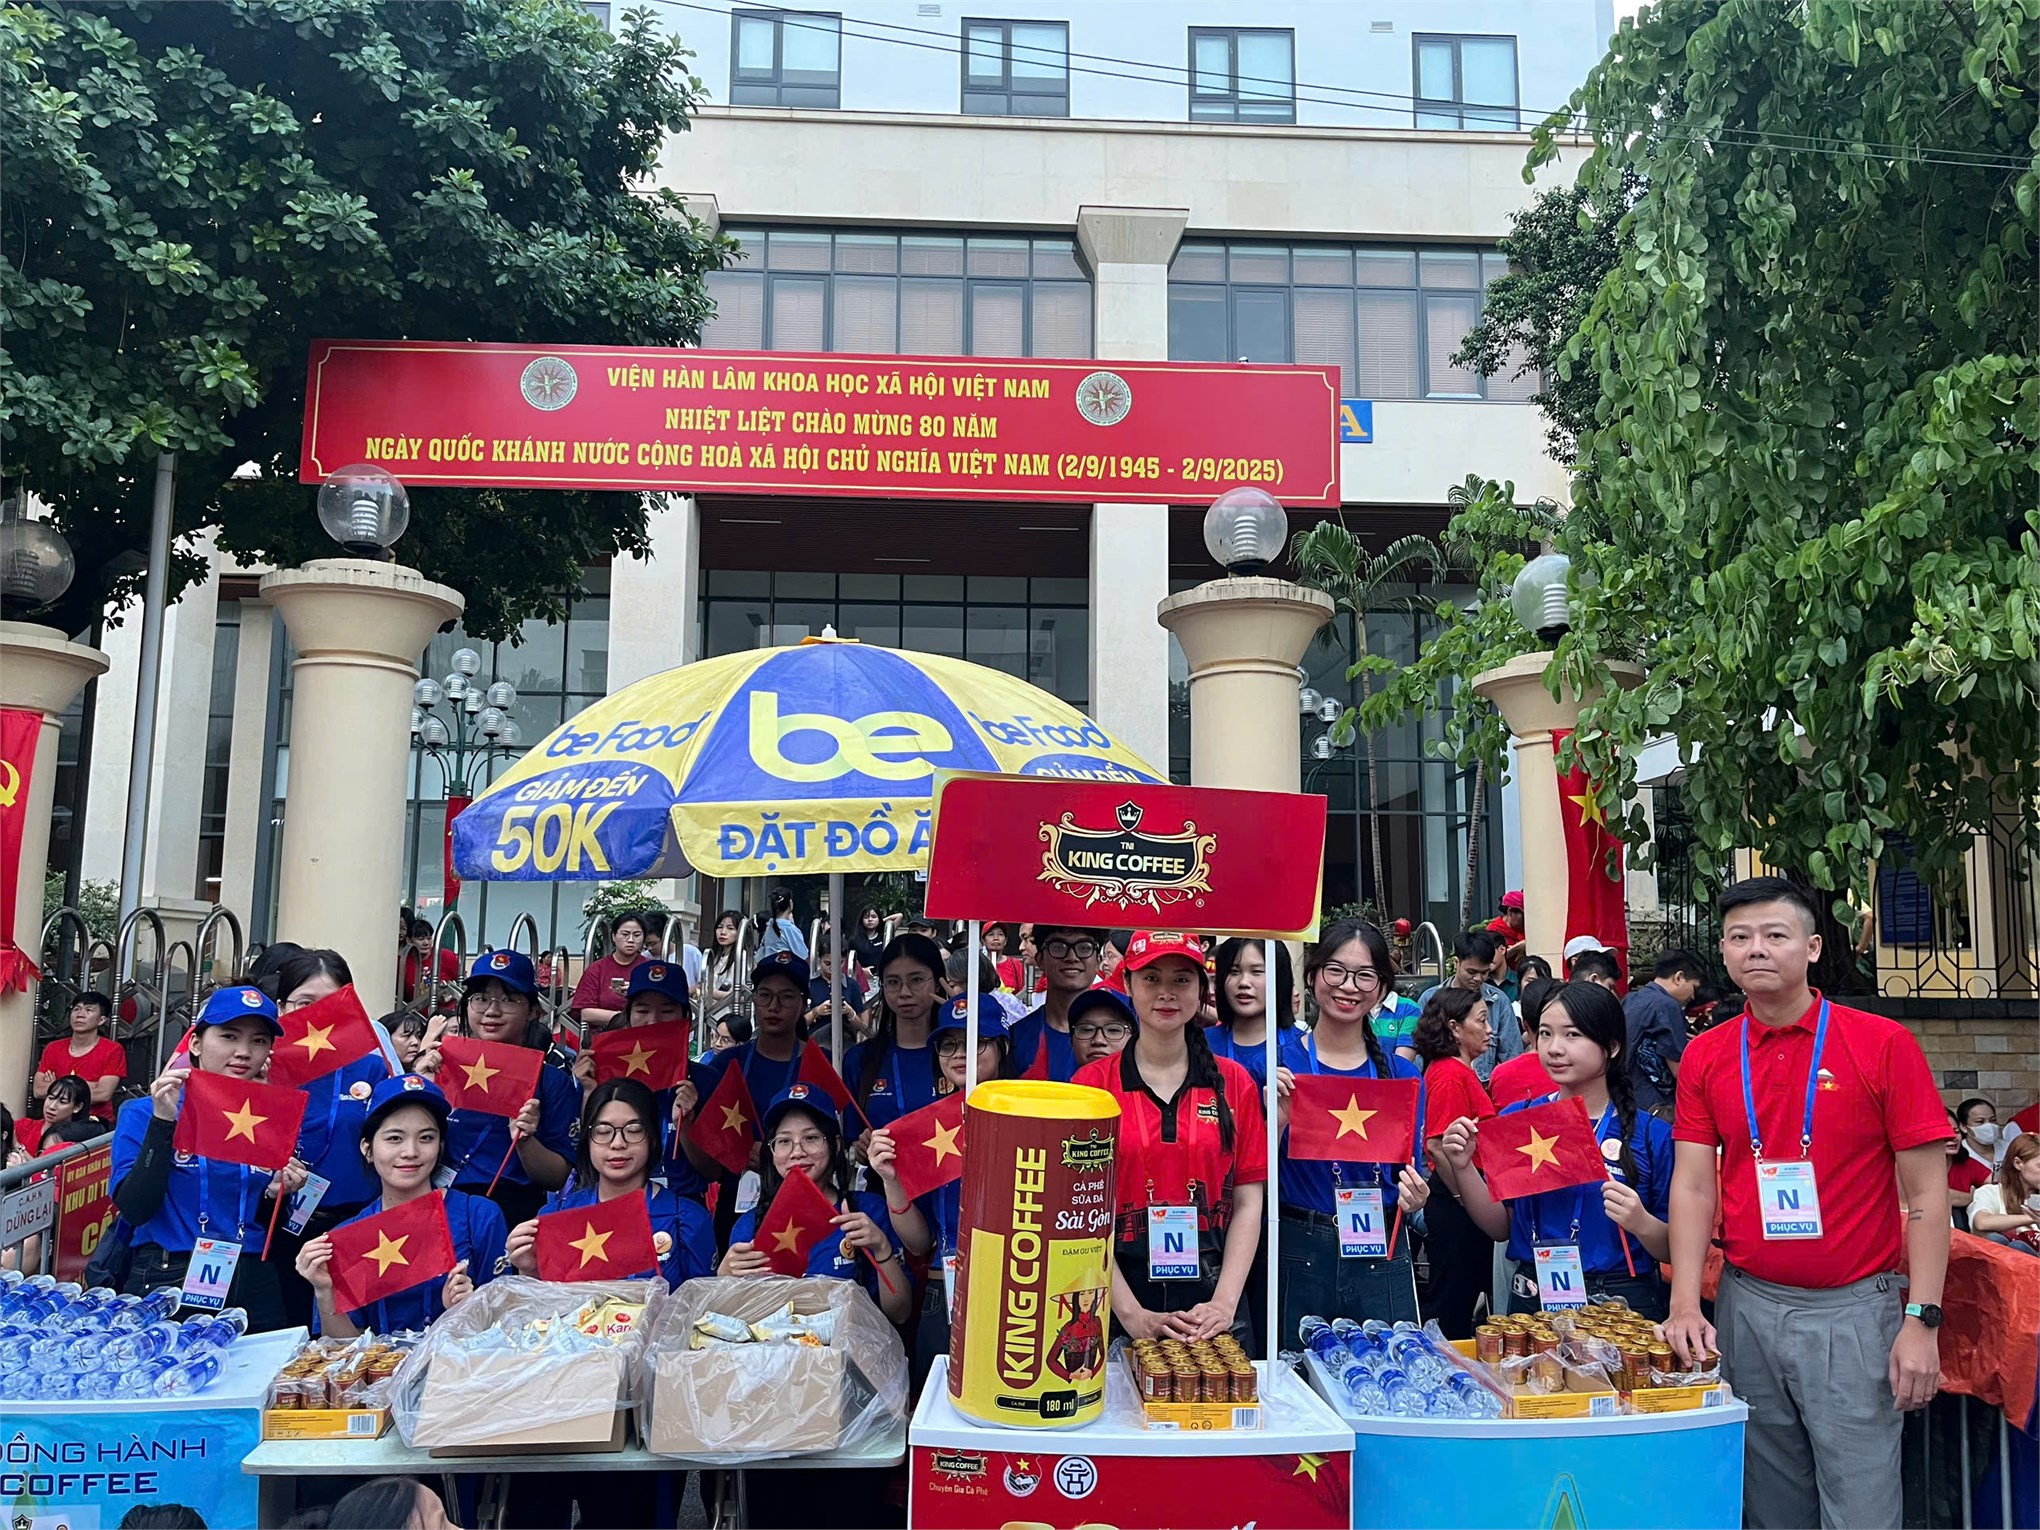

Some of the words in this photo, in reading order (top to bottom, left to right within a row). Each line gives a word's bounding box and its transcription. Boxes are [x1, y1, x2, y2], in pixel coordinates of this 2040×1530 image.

[608, 365, 655, 389] VIỆN
[663, 369, 705, 389] HÀN
[712, 370, 756, 390] LÂM
[763, 372, 819, 392] KHOA
[826, 374, 869, 396] HỌC
[876, 372, 903, 395] XÃ
[909, 373, 945, 399] HỘI
[952, 374, 997, 400] VIỆT
[1004, 379, 1050, 398] NAM
[665, 408, 731, 432] NHIỆT
[737, 408, 786, 433] LIỆT
[792, 411, 847, 435] CHÀO
[853, 414, 913, 436] MỪNG
[919, 415, 946, 437] 80
[953, 414, 997, 438] NĂM
[365, 437, 423, 460] NGÀY
[429, 436, 485, 462] QUỐC
[492, 439, 565, 463] KHÁNH
[573, 442, 630, 465] NƯỚC
[637, 441, 693, 468] CỘNG
[700, 445, 743, 468] HOÀ
[749, 446, 776, 469] XÃ
[783, 444, 819, 472] HỘI
[827, 448, 870, 472] CHỦ
[877, 450, 942, 474] NGHĨA
[948, 451, 998, 476] VIỆT
[1004, 453, 1050, 476] NAM
[1057, 454, 1160, 479] (2/9/1945
[1182, 458, 1284, 482] 2/9/2025)
[546, 725, 596, 758] be
[597, 711, 710, 754] Food
[749, 691, 953, 782] be
[968, 710, 1030, 746] be
[1018, 714, 1110, 749] Food
[515, 770, 589, 802] GIẢM
[584, 762, 648, 795] ĐẾN
[491, 801, 623, 873] 50K
[717, 810, 815, 871] ĐẶT
[824, 796, 907, 858] ĐỒ
[1068, 850, 1114, 872] KING
[1115, 853, 1186, 876] COFFEE
[1073, 1180, 1087, 1191] CÀ
[1088, 1179, 1105, 1191] PHÊ
[65, 1187, 86, 1214] KHU
[1071, 1193, 1092, 1205] SỮA
[1093, 1191, 1104, 1203] ĐÁ
[1777, 1188, 1800, 1211] N
[1010, 1146, 1047, 1285] COFFEE
[1055, 1210, 1085, 1231] Sài
[1088, 1208, 1111, 1233] Gòn
[1351, 1213, 1371, 1233] N
[1770, 1222, 1798, 1234] PHỤC
[1799, 1222, 1813, 1233] VỤ
[1080, 1247, 1090, 1255] GU
[1164, 1232, 1184, 1253] N
[1345, 1245, 1369, 1255] PHỤC
[1370, 1244, 1382, 1255] VỤ
[199, 1264, 222, 1285] N
[1155, 1265, 1180, 1276] PHỤC
[1181, 1265, 1194, 1276] VỤ
[1551, 1271, 1571, 1291] N
[184, 1293, 209, 1305] PHỤC
[208, 1297, 221, 1307] VỤ
[1003, 1288, 1039, 1381] KING
[1046, 1399, 1061, 1412] 180
[1063, 1398, 1075, 1411] ml
[0, 1431, 86, 1466] ỒNG
[98, 1433, 206, 1464] HÀNH
[940, 1460, 955, 1469] KING
[955, 1461, 979, 1470] COFFEE
[0, 1471, 158, 1496] COFFEE
[953, 1484, 965, 1494] Gia
